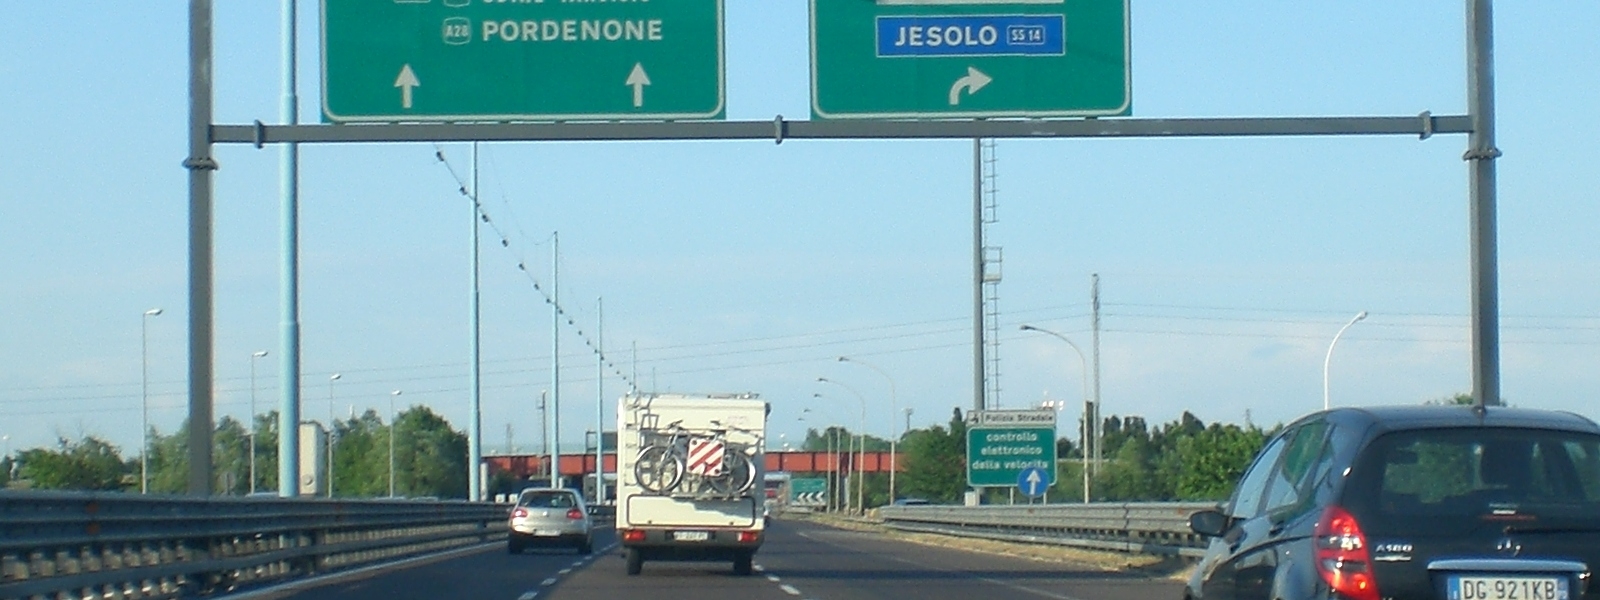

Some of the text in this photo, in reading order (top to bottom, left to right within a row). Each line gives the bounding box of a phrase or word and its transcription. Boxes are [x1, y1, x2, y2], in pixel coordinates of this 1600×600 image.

[445, 20, 663, 41] A28 PORDENONE
[895, 25, 1042, 46] JESOLO SS 14
[985, 414, 1053, 422] Polizia Stradale
[986, 432, 1038, 442] controllo
[981, 445, 1043, 455] elettronico
[972, 460, 1000, 470] della
[1463, 580, 1486, 600] DG
